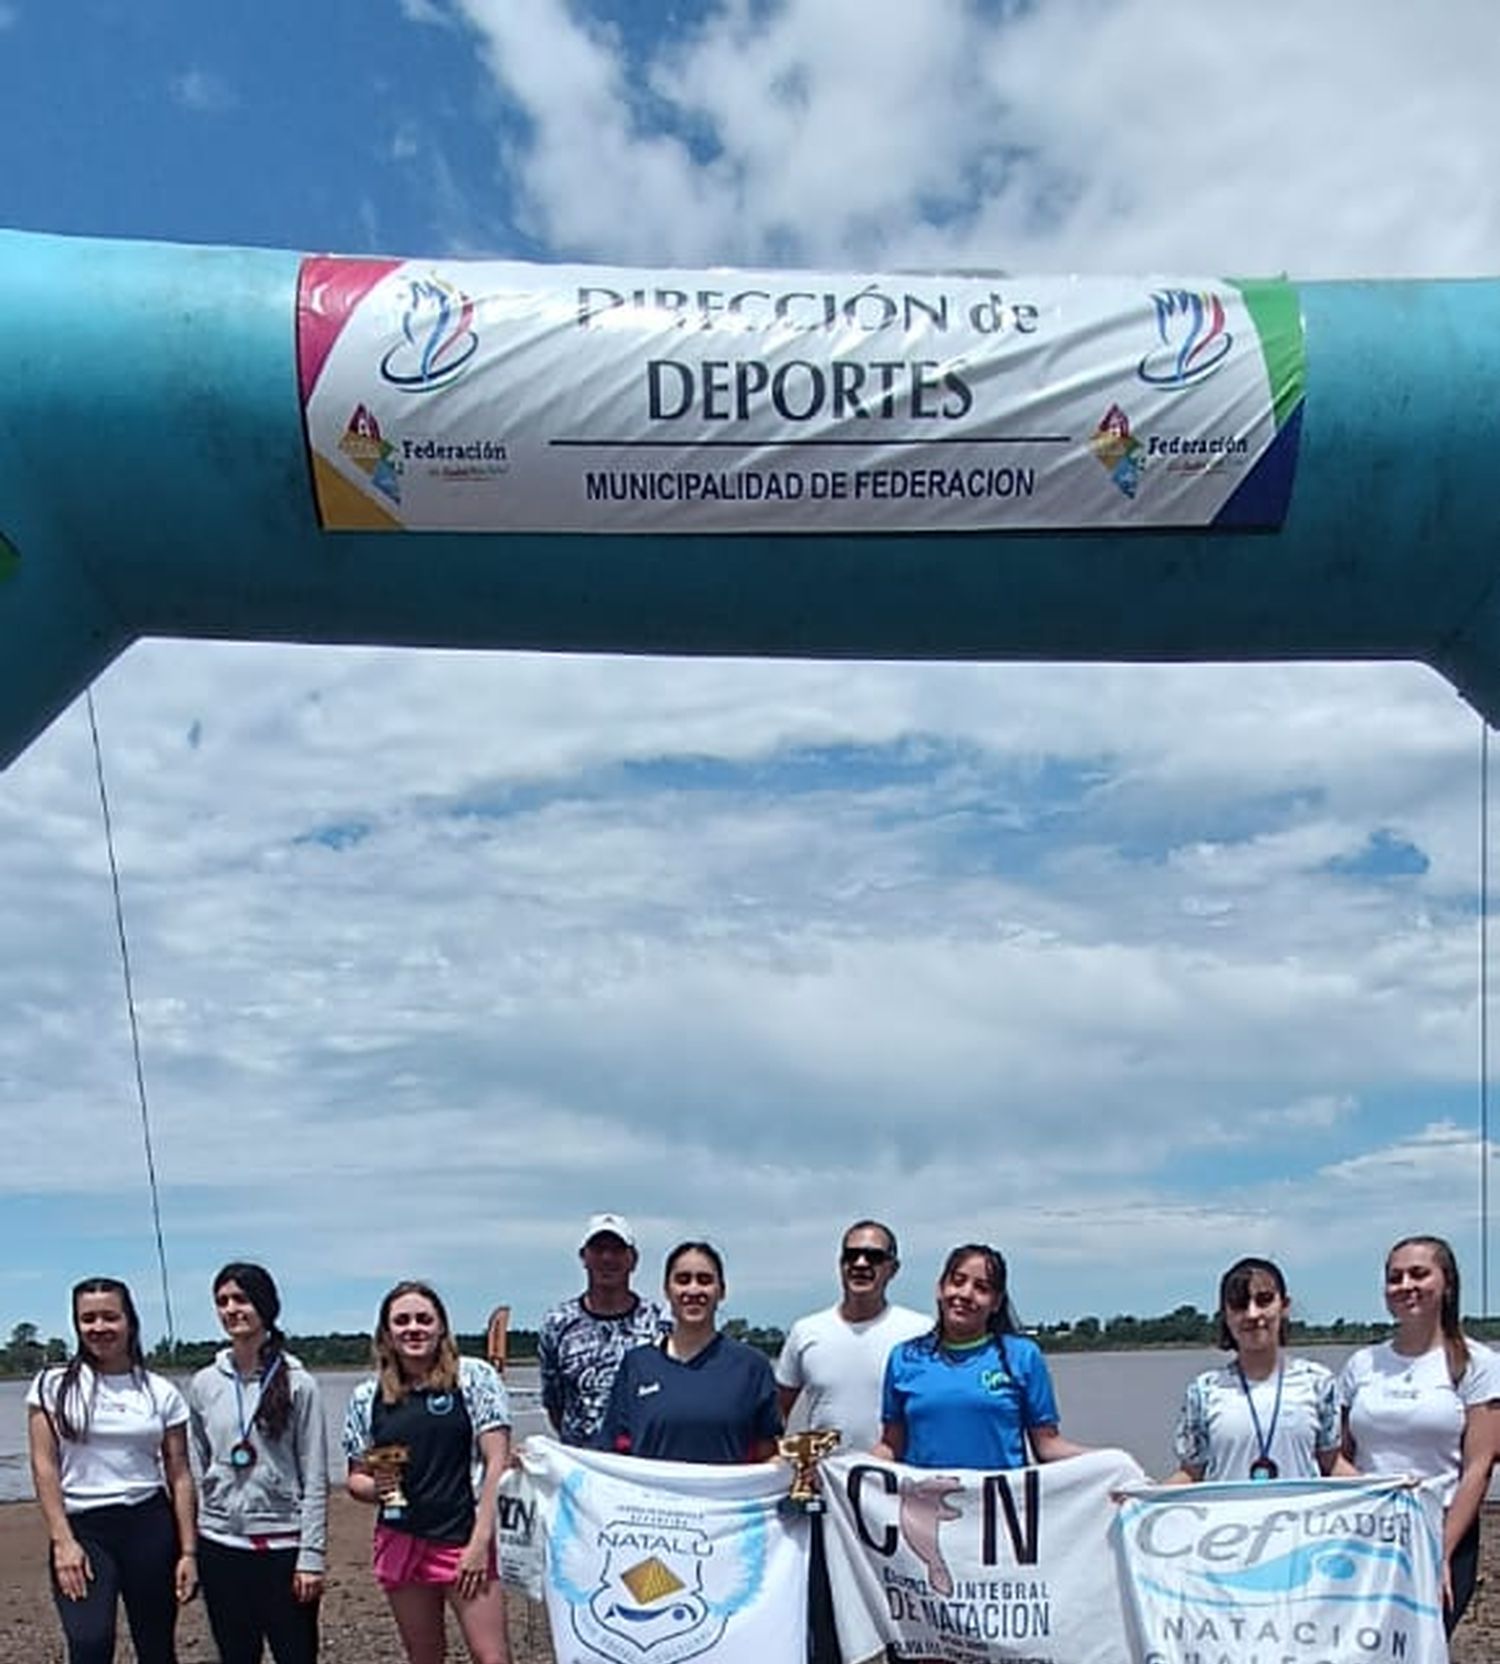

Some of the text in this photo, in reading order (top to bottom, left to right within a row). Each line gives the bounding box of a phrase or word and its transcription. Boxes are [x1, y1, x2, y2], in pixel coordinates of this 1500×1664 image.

[969, 290, 1040, 334] de
[648, 357, 973, 422] DEPORTES
[402, 440, 508, 460] Federación
[1148, 434, 1249, 455] Federación
[585, 469, 1034, 501] MUNICIPALIDAD DE FEDERACION
[1136, 1504, 1299, 1564] Cef
[885, 1586, 1051, 1640] DE NATACION
[956, 1582, 1050, 1602] INTEGRAL
[1164, 1617, 1408, 1660] NATACION
